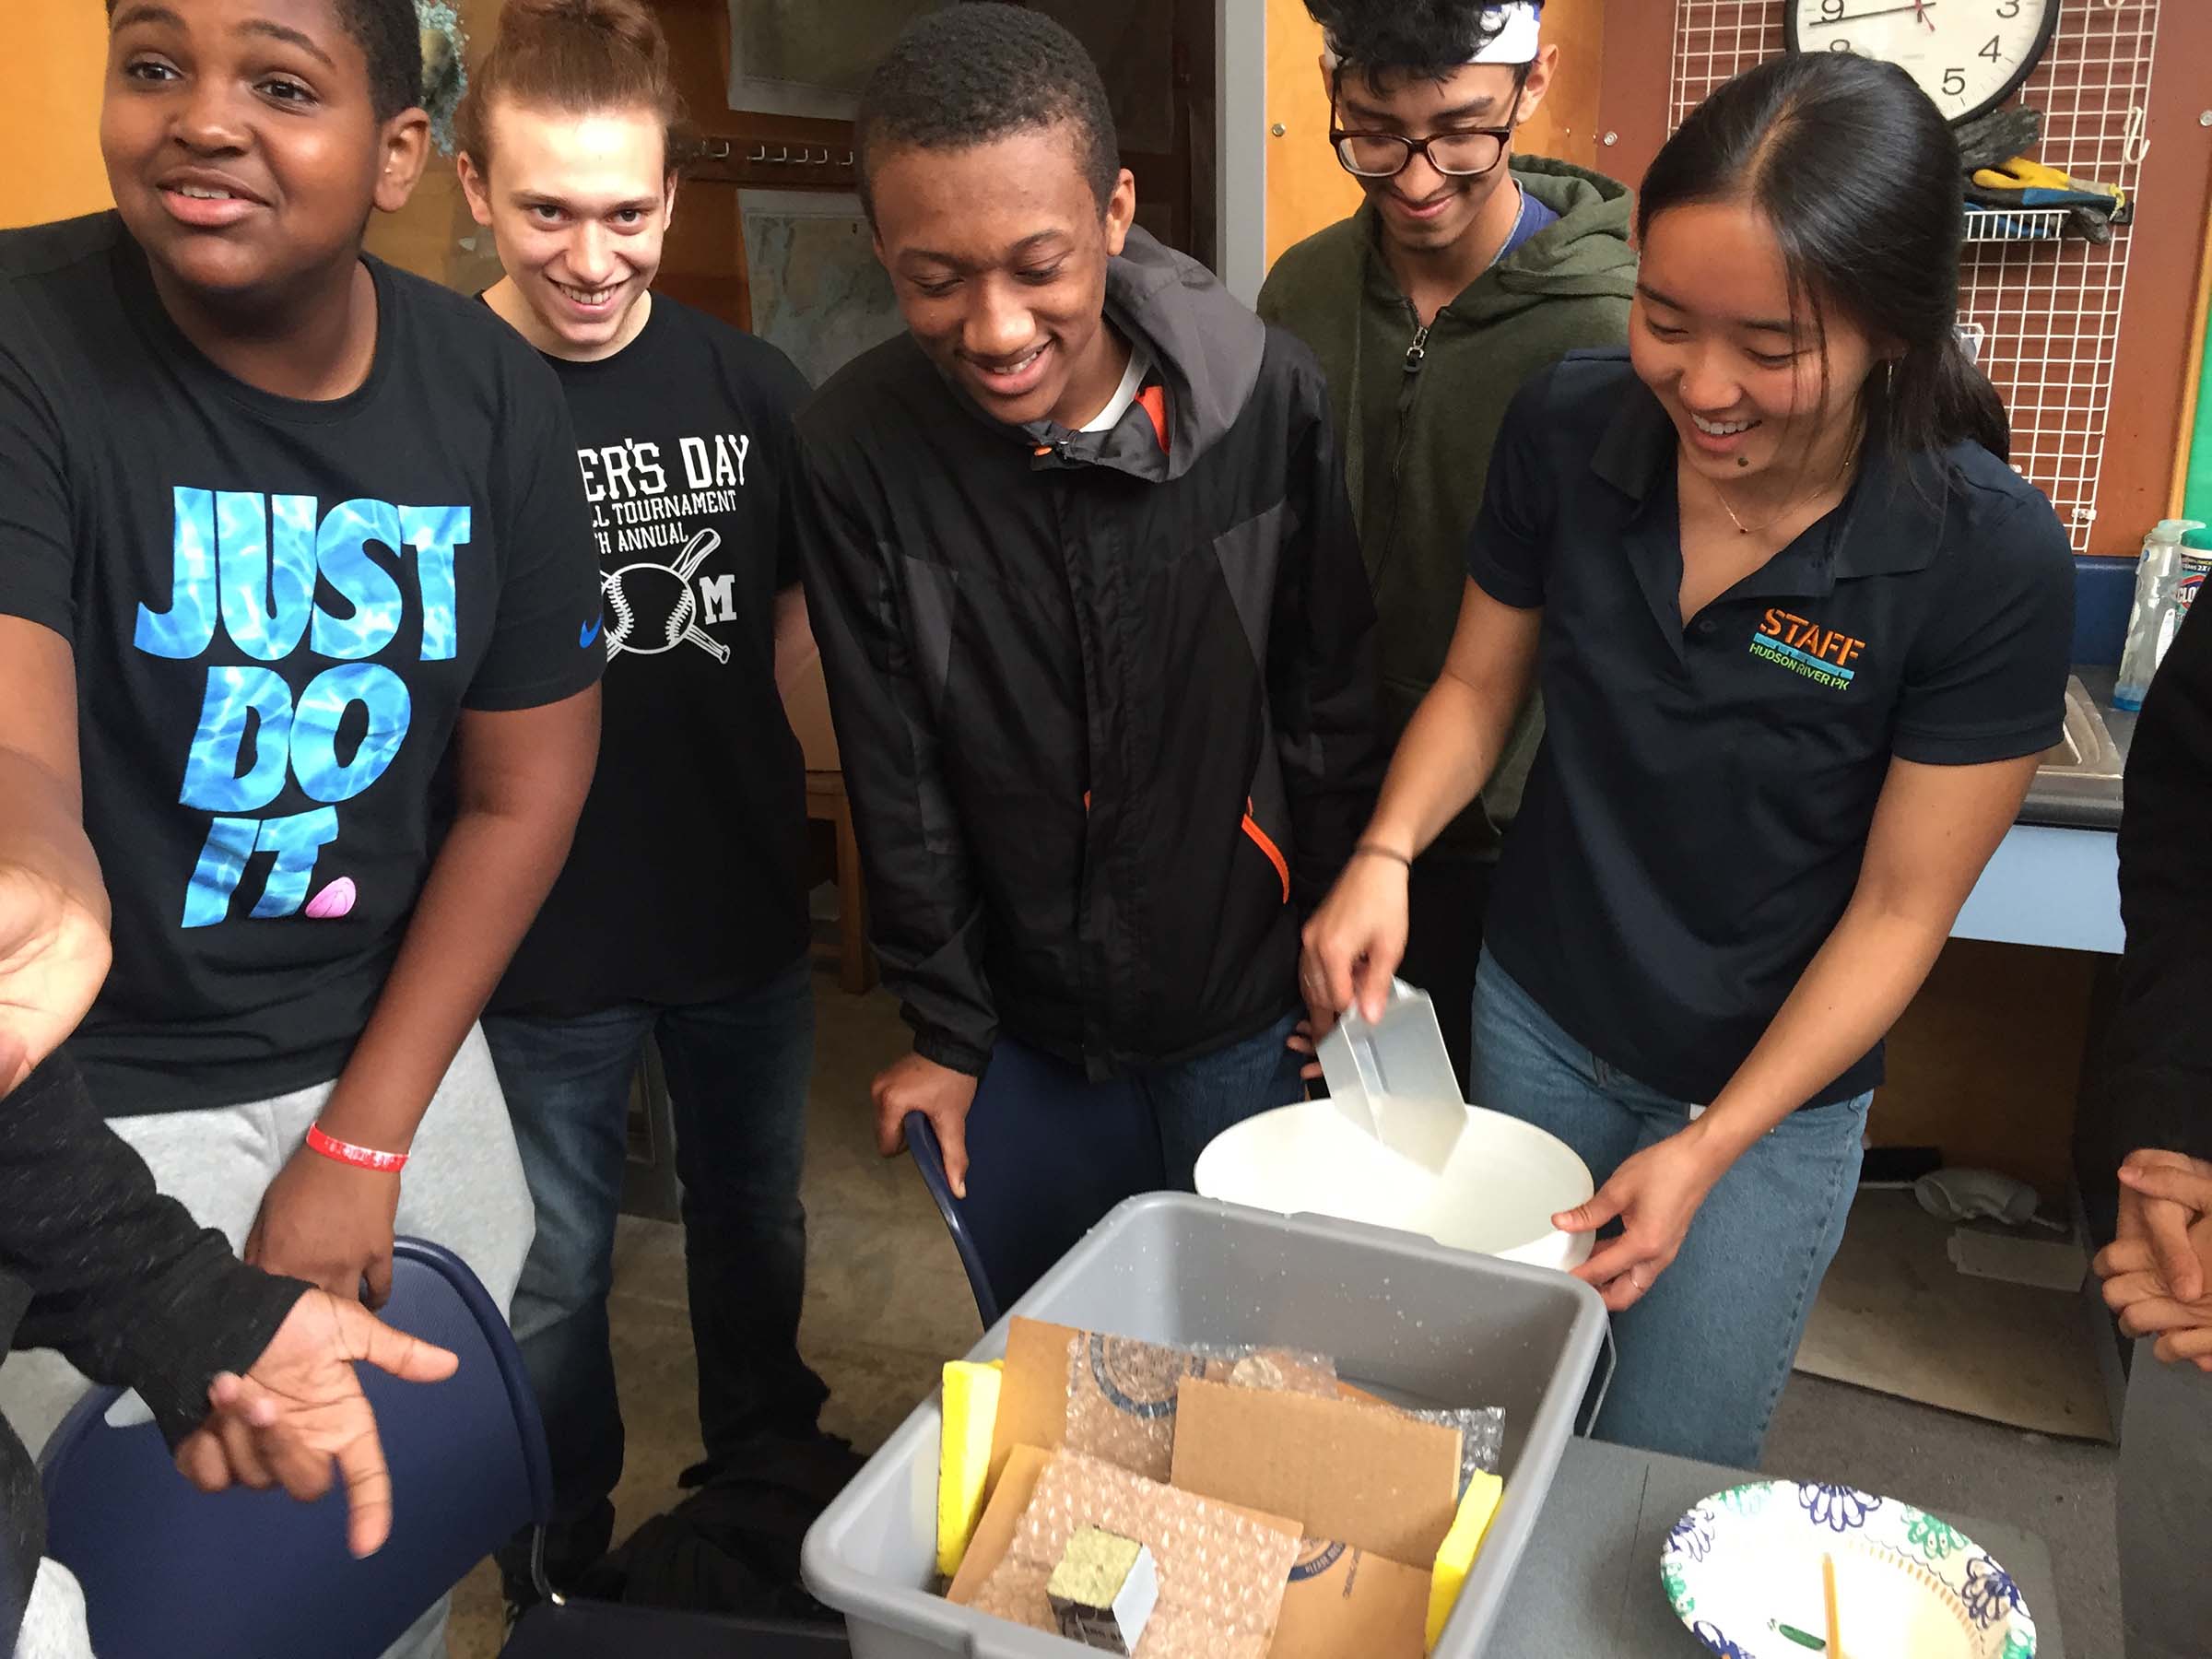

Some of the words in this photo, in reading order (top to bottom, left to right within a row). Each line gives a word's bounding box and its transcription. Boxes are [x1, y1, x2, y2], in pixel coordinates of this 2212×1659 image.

[1821, 0, 1844, 23] 9
[1996, 0, 2020, 18] 3
[1978, 35, 2002, 63] 4
[1941, 68, 1966, 96] 5
[679, 435, 749, 488] DAY
[593, 504, 610, 528] L
[611, 489, 736, 525] TOURNAMENT
[594, 531, 612, 554] H
[618, 522, 689, 552] ANNUAL
[134, 486, 471, 660] JUST
[699, 574, 737, 625] M
[2176, 586, 2200, 604] CLO
[1759, 608, 1865, 665] STAFF
[1749, 643, 1798, 672] HUDSON
[1795, 664, 1830, 686] RIVER
[1830, 677, 1850, 690] PK
[179, 663, 411, 812] DO
